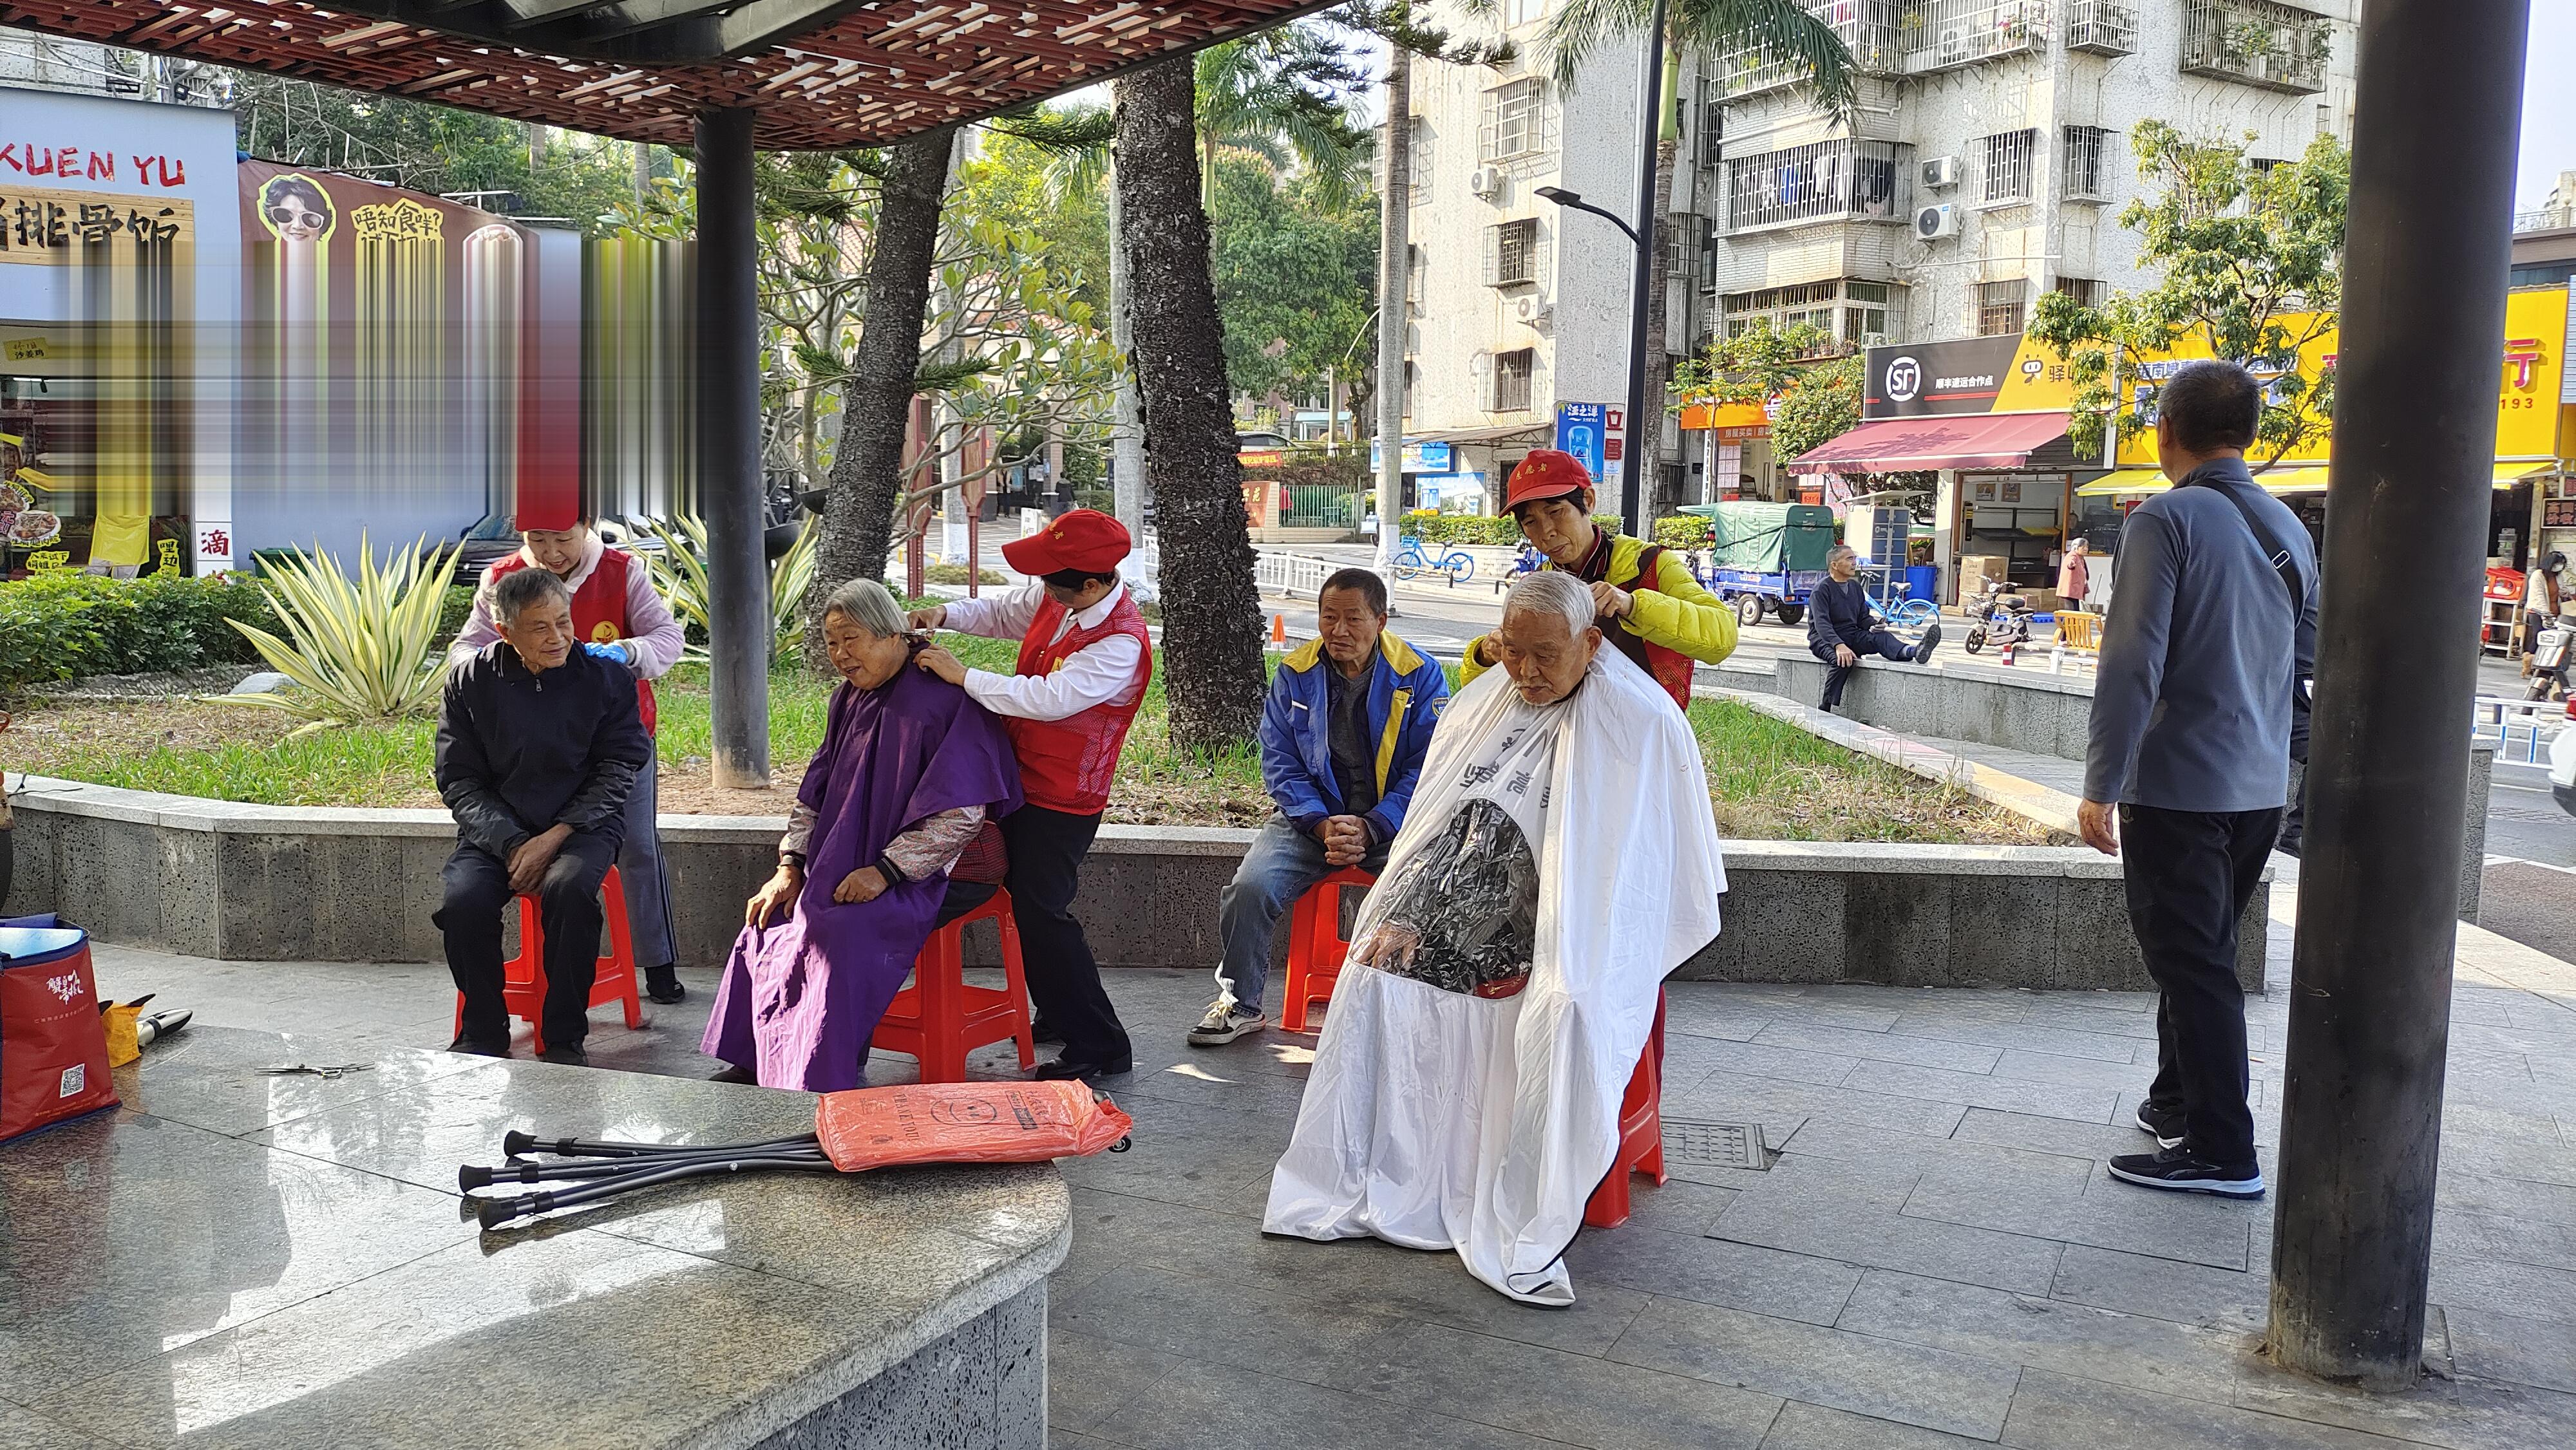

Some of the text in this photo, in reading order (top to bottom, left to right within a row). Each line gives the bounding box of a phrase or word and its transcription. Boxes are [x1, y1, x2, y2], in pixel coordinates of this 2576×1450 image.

[133, 155, 185, 187] YU
[1935, 375, 1993, 390] 顺丰速运合作点
